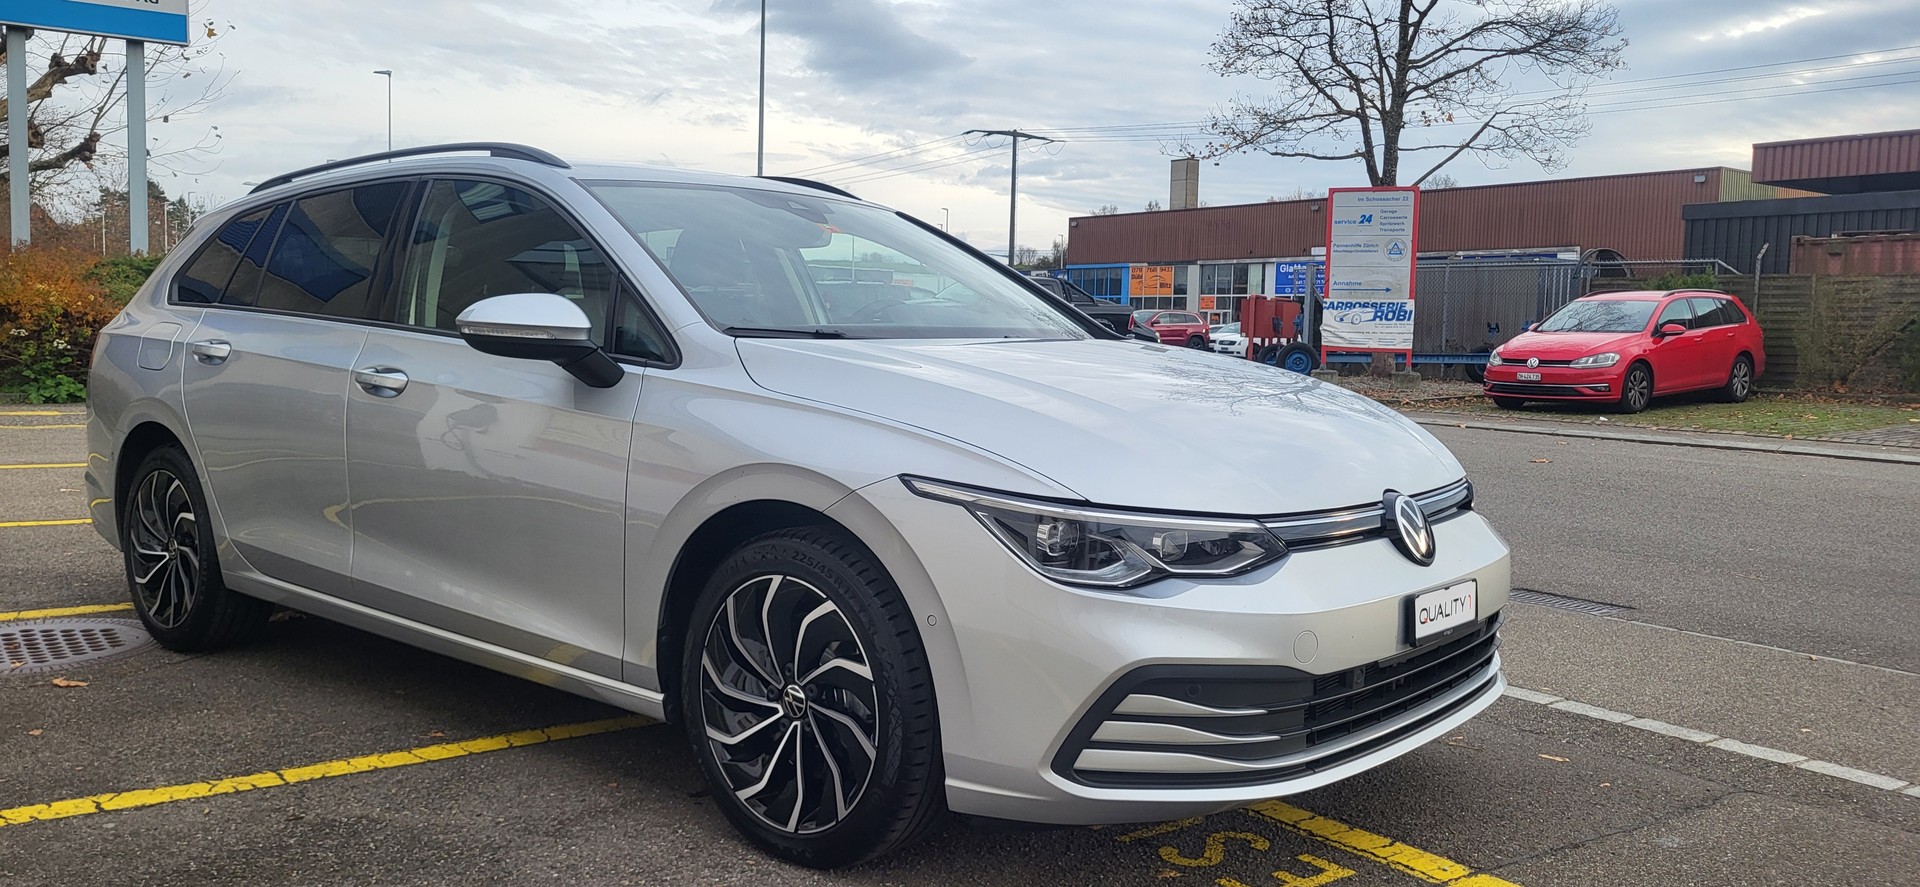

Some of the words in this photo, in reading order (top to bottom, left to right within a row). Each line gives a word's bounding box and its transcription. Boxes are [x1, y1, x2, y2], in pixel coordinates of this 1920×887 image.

[1358, 213, 1374, 224] 24
[1322, 301, 1408, 311] CARROSSERIE
[1372, 310, 1414, 322] ROBI
